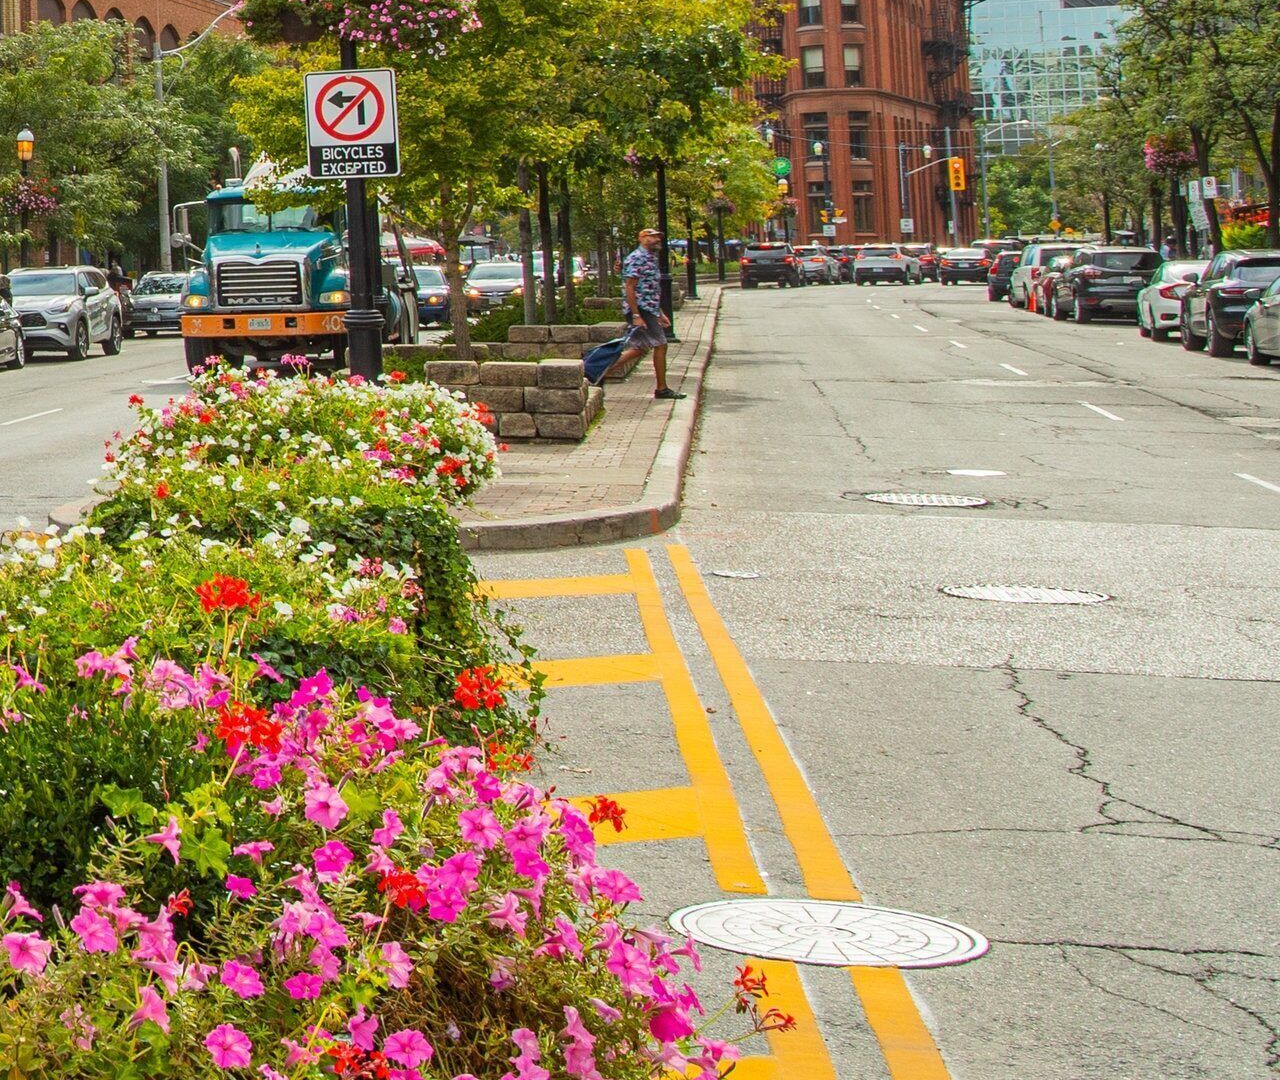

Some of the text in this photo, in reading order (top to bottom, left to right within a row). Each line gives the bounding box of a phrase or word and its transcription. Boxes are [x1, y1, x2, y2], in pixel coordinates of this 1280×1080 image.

[321, 145, 385, 160] BICYCLES
[321, 161, 387, 175] EXCEPTED
[227, 296, 293, 305] MACK
